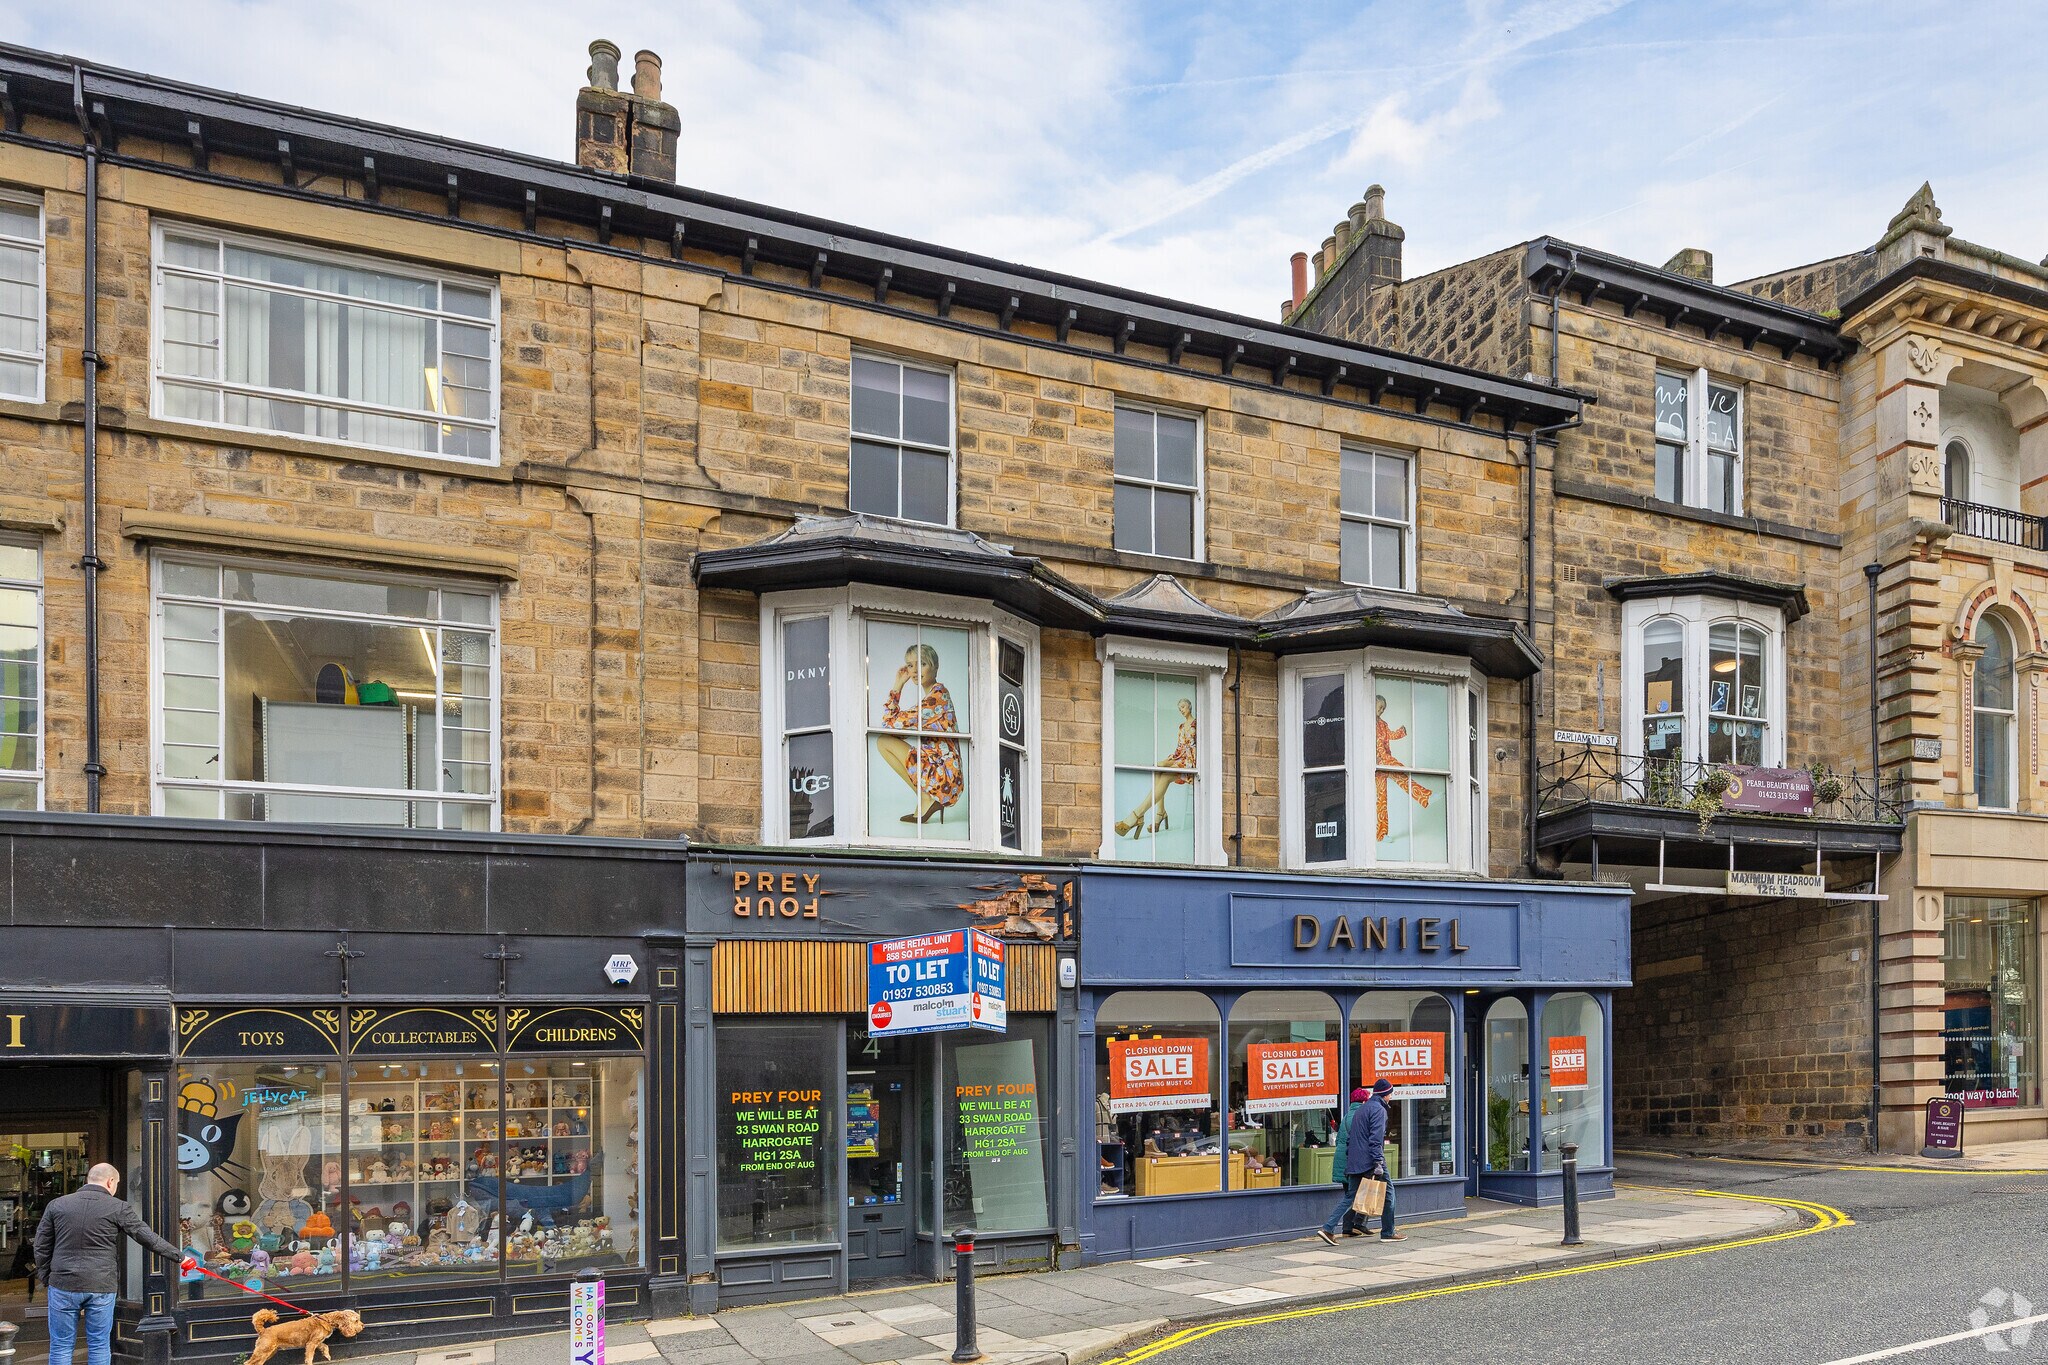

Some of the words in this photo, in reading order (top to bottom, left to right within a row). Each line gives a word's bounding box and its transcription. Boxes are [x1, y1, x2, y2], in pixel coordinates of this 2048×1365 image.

[787, 666, 827, 681] DKNY
[1556, 731, 1602, 744] PARLIAMENT
[1605, 736, 1615, 745] ST
[791, 774, 831, 795] UGG
[1746, 779, 1765, 788] PEARL
[1766, 781, 1789, 790] BEAUTY
[1790, 782, 1796, 790] &
[1796, 784, 1810, 792] HAIR
[1758, 790, 1776, 799] 01423
[1777, 792, 1788, 800] 313
[1788, 792, 1800, 801] 568
[1001, 804, 1015, 823] FLY
[734, 871, 820, 893] PREY
[1730, 872, 1775, 884] MAXIMUM
[1777, 874, 1822, 887] HEADROOM
[1779, 886, 1798, 897] 3ins.
[733, 896, 819, 918] FOUR
[1293, 914, 1471, 951] DANIEL
[882, 940, 906, 952] PRIME
[907, 937, 933, 950] RETAIL
[934, 934, 952, 945] UNIT
[886, 952, 900, 962] 858
[901, 950, 913, 960] SQ
[914, 948, 924, 956] FT
[926, 946, 949, 956] (Approx)
[886, 964, 910, 984] TO
[916, 958, 950, 981] LET
[978, 958, 987, 978] TO
[988, 961, 1000, 982] LET
[882, 987, 912, 1001] 01937
[915, 982, 954, 998] 530853
[913, 999, 954, 1012] malcolm
[936, 1005, 968, 1018] stuart
[6, 1014, 26, 1048] I
[371, 1031, 477, 1045] COLLECTABLES
[534, 1028, 617, 1042] CHILDRENS
[238, 1032, 285, 1046] TOYS
[1374, 1038, 1408, 1047] CLOSING
[1410, 1038, 1432, 1046] DOWN
[862, 1037, 882, 1060] 4
[1125, 1046, 1164, 1056] CLOSING
[1166, 1045, 1193, 1054] DOWN
[1262, 1050, 1298, 1058] CLOSING
[1300, 1048, 1324, 1057] DOWN
[1378, 1050, 1427, 1068] SALE
[1554, 1056, 1583, 1066] SALE
[1130, 1057, 1188, 1078] SALE
[1266, 1060, 1320, 1080] SALE
[1126, 1080, 1165, 1090] EVERYTHING
[1166, 1080, 1182, 1088] MUST
[1487, 1072, 1526, 1085] DANIEL
[956, 1084, 992, 1098] PREY
[996, 1083, 1035, 1096] FOUR
[1263, 1083, 1298, 1091] EVERYTHING
[731, 1091, 773, 1104] PREY
[778, 1090, 822, 1102] FOUR
[1175, 1098, 1209, 1106] FOOTWEAR
[1966, 1090, 1984, 1102] way
[1986, 1089, 1994, 1098] to
[960, 1102, 976, 1111] WE
[978, 1101, 1002, 1110] WILL
[1004, 1100, 1018, 1110] BE
[1019, 1100, 1032, 1109] AT
[736, 1111, 755, 1122] WE
[758, 1110, 785, 1120] WILL
[787, 1110, 802, 1120] BE
[804, 1109, 819, 1119] AT
[959, 1114, 971, 1124] 33
[972, 1114, 1001, 1123] SWAN
[1004, 1112, 1032, 1122] ROAD
[736, 1124, 749, 1135] 33
[751, 1124, 785, 1134] SWAN
[787, 1122, 820, 1133] ROAD
[964, 1124, 1026, 1137] HARROGATE
[742, 1136, 813, 1148] HARROGATE
[974, 1139, 995, 1149] HG1
[997, 1138, 1017, 1148] 2SA
[754, 1150, 776, 1161] HG1
[779, 1150, 802, 1160] 2SA
[740, 1163, 764, 1172] FROM
[784, 1162, 796, 1170] OF
[797, 1160, 815, 1169] AUG
[574, 1287, 583, 1348] WELCOMES
[586, 1286, 594, 1348] HARROGATE
